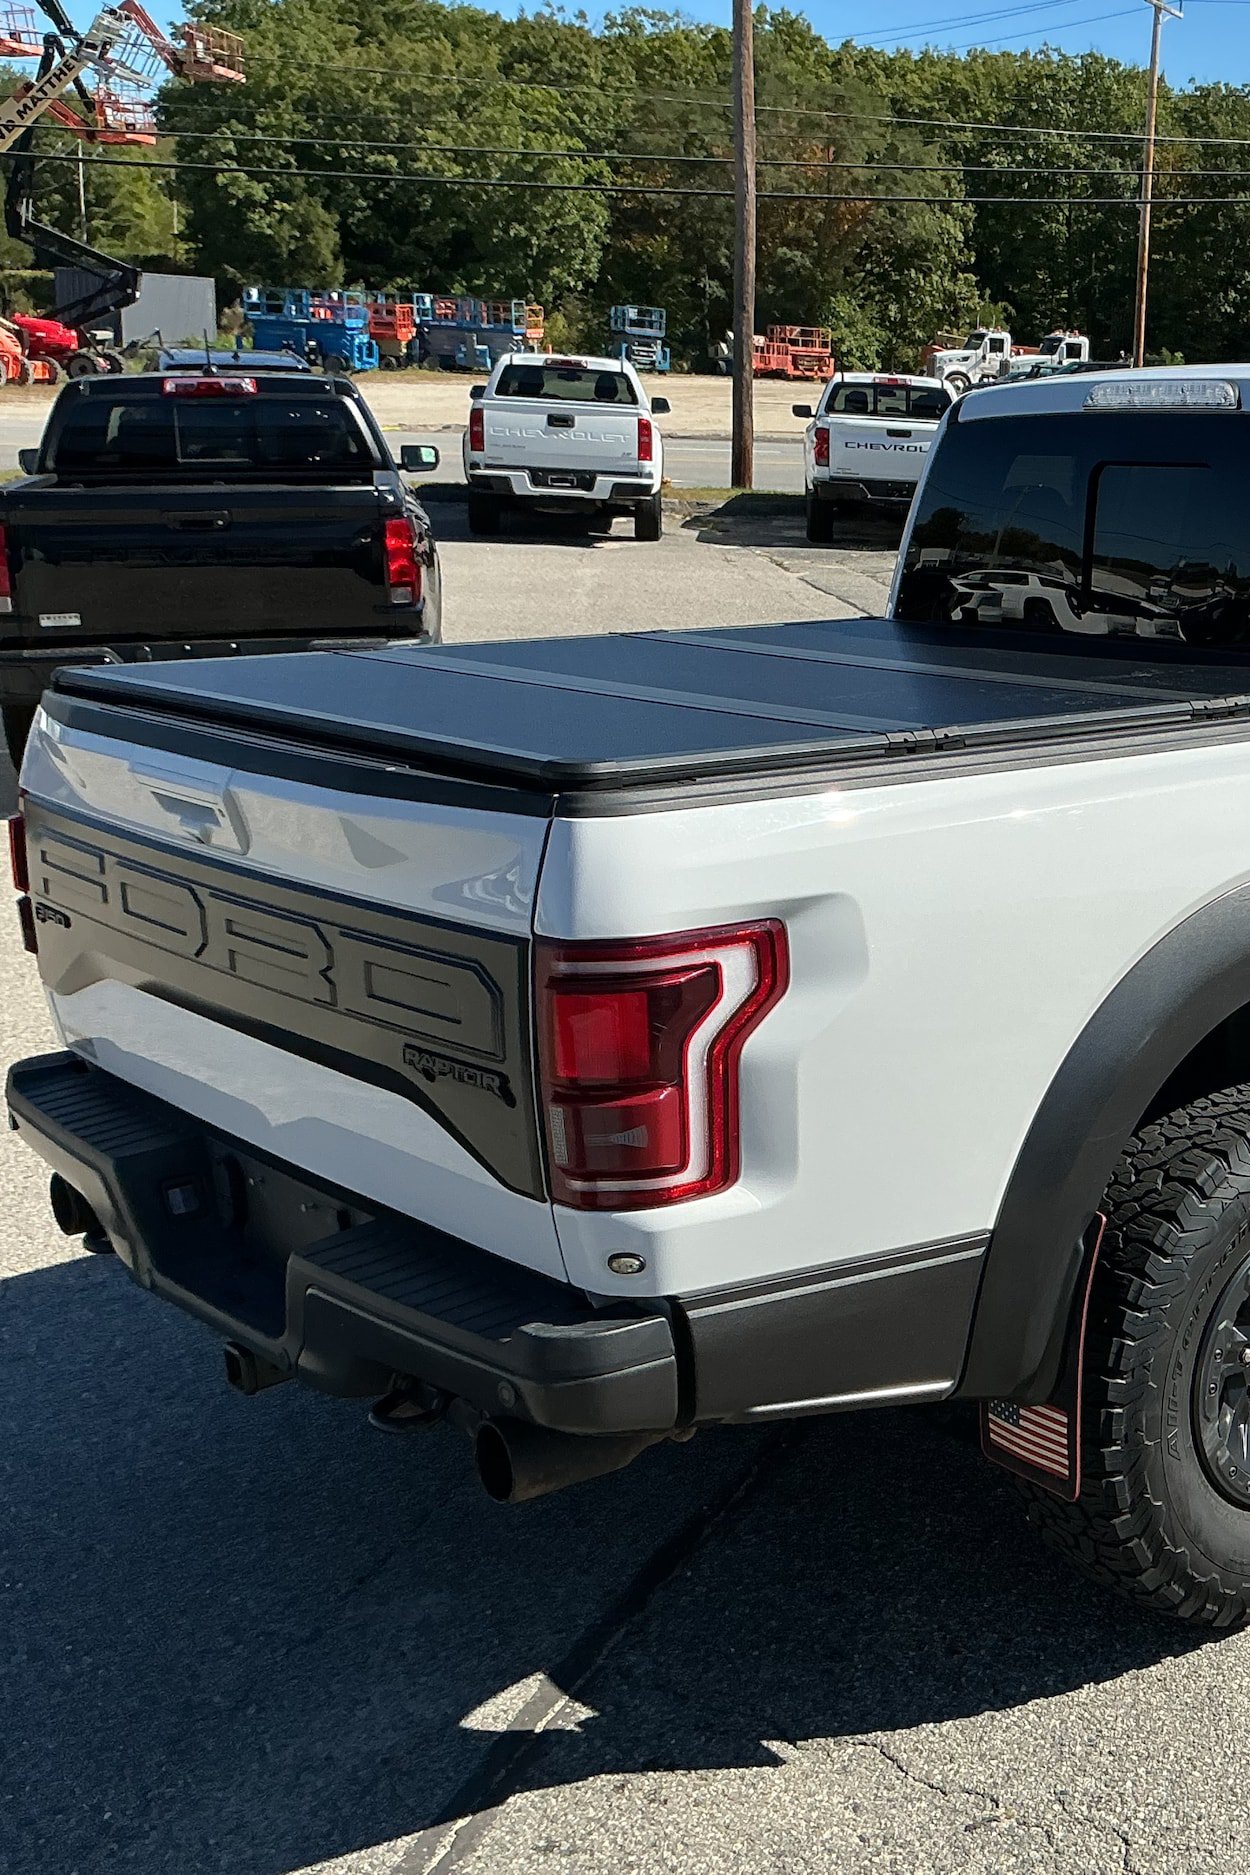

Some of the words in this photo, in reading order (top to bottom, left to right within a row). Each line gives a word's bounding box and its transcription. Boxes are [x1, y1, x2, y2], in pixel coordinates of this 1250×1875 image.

[489, 427, 631, 443] CHEVROLET
[38, 826, 506, 1062] FORD
[402, 1046, 505, 1100] RAPTOR
